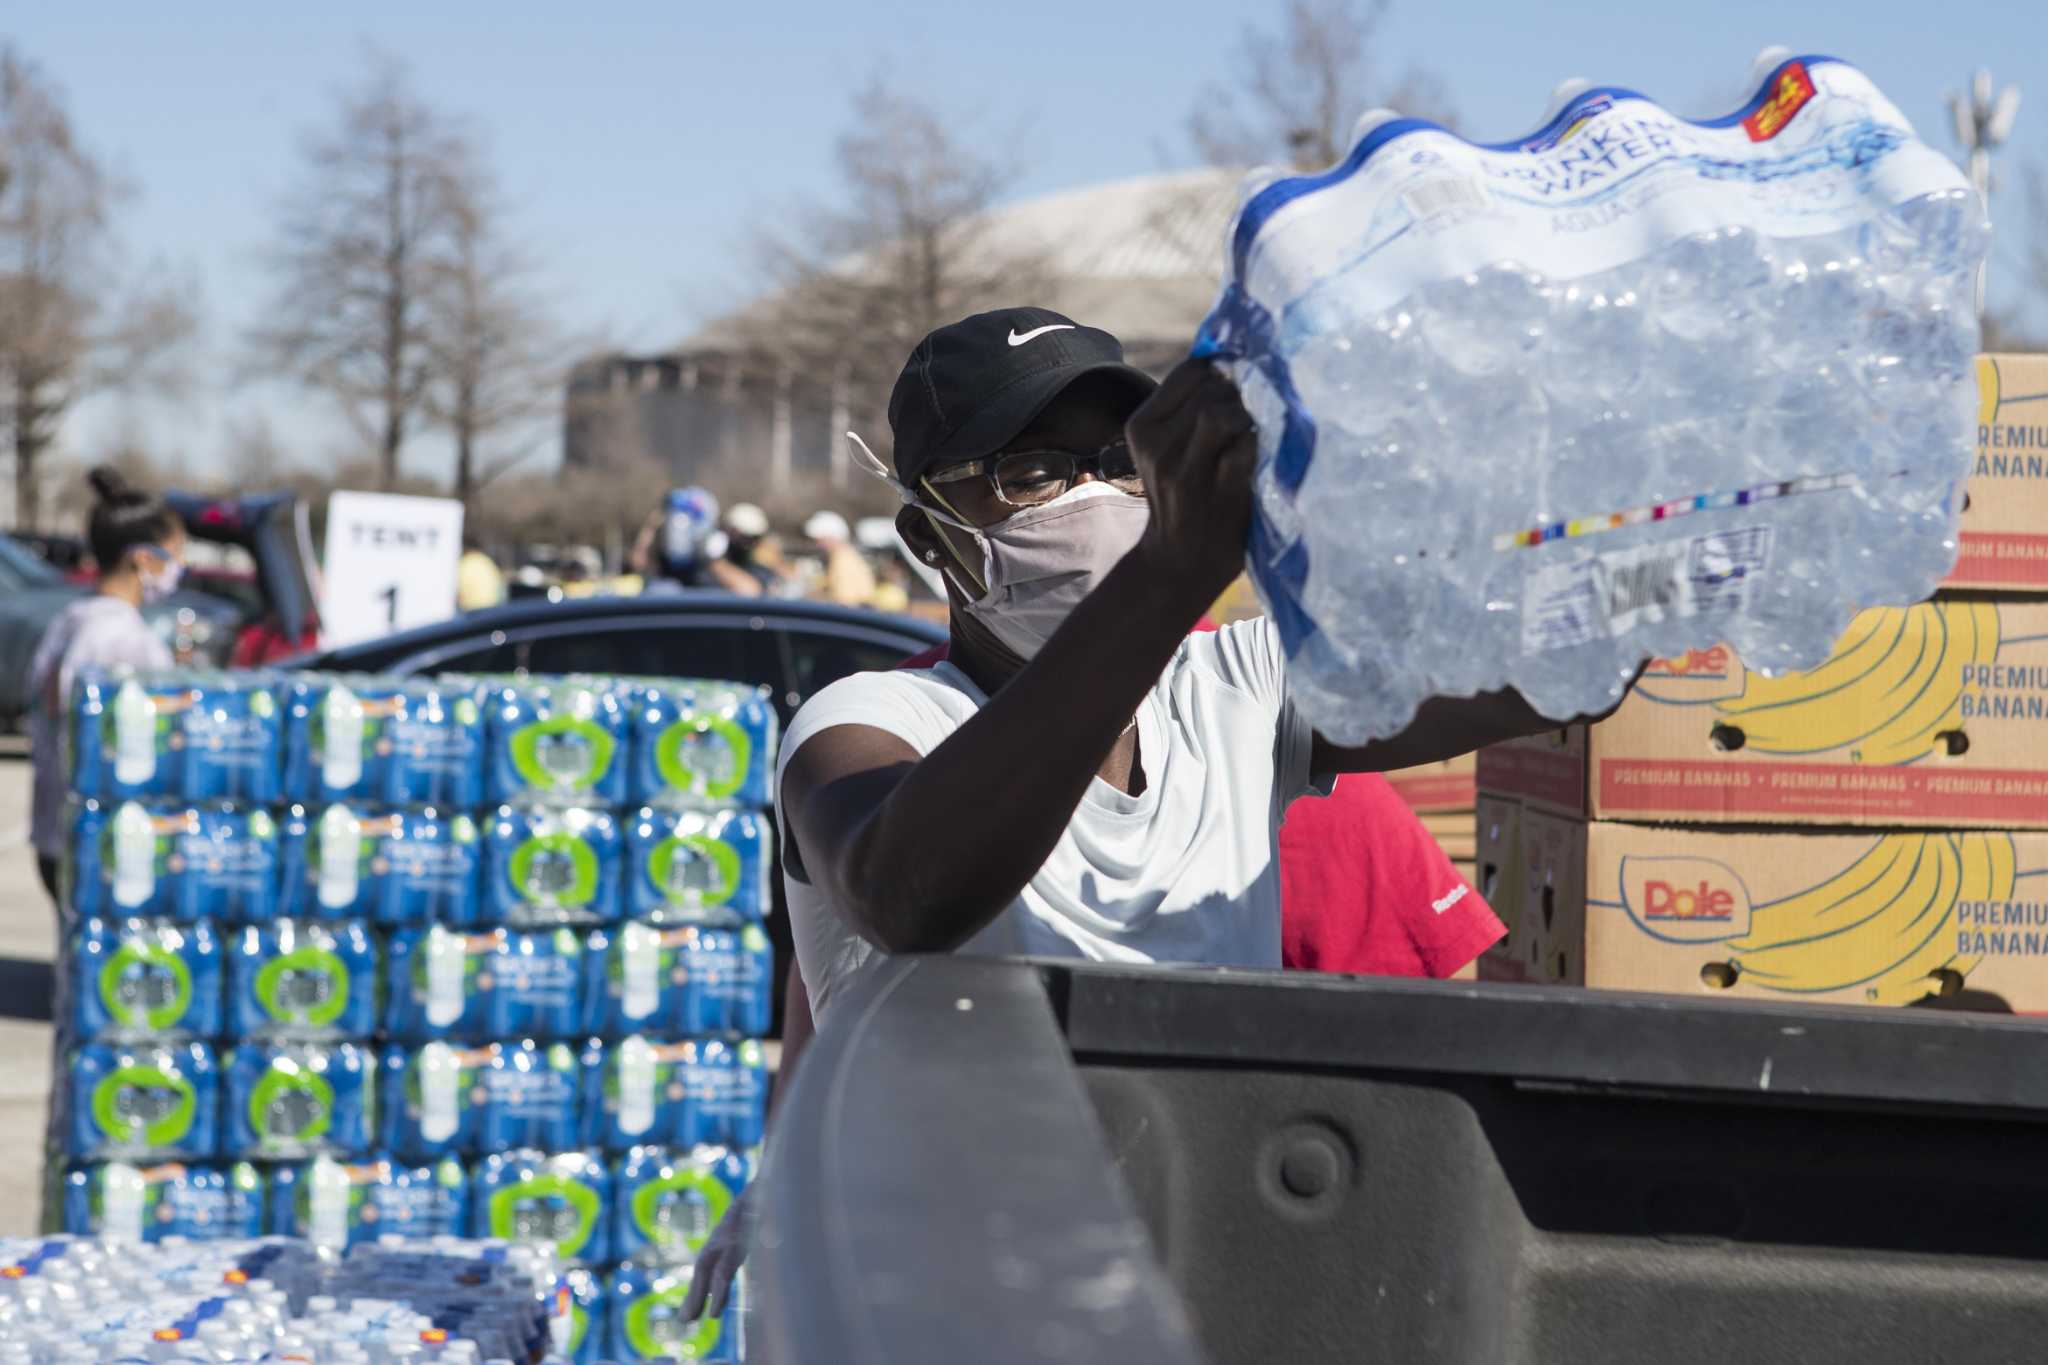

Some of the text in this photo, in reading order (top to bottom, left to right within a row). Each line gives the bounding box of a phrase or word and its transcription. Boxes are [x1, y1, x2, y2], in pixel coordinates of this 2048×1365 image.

[1530, 133, 1678, 196] WATER
[1977, 424, 2048, 449] REMIU
[1972, 454, 2048, 478] ANAN
[351, 521, 441, 550] TENT
[378, 584, 399, 625] 1
[1962, 664, 2048, 690] PREMIU
[1961, 693, 2048, 720] BANAN
[1614, 768, 1681, 786] PREMIUM
[1684, 769, 1750, 787] BANANAS
[1771, 772, 1837, 789] PREMIUM
[1841, 773, 1906, 792] BANANAS
[1927, 776, 1991, 794] PREMIUM
[1644, 879, 1735, 918] Dole
[1958, 901, 2048, 926] PREMIU
